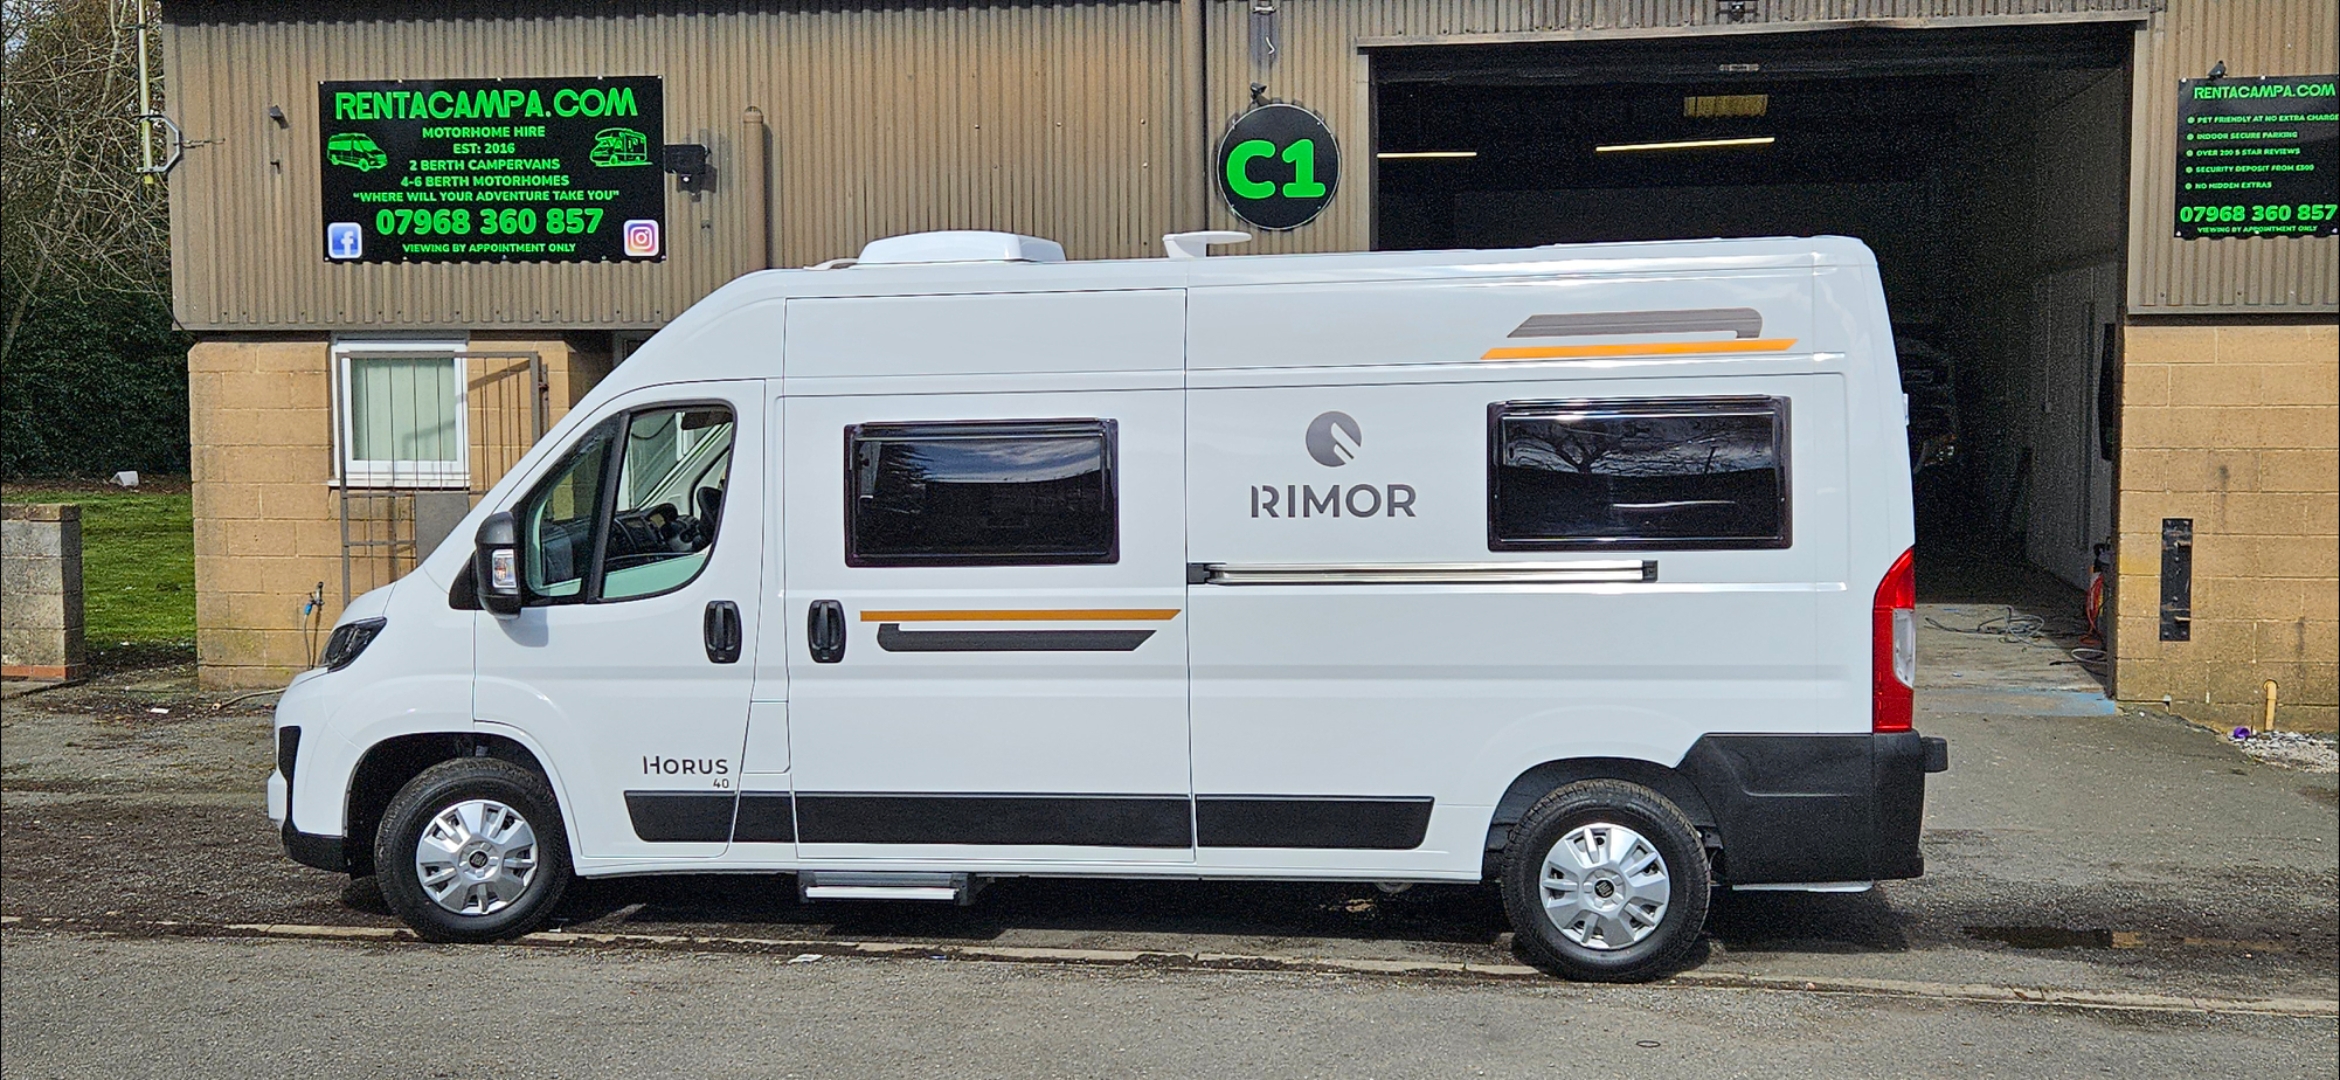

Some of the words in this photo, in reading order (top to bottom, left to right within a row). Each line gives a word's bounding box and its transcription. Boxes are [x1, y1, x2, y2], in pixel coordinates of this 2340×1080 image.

[2194, 83, 2335, 99] RENTACAMPA.COM
[335, 87, 638, 120] RENTACAMPA.COM
[2197, 116, 2212, 124] PET
[2214, 115, 2251, 123] FRIENDLY
[422, 126, 510, 138] MOTORHOME
[514, 126, 545, 137] HIRE
[2262, 131, 2298, 139] PARKING
[453, 142, 481, 154] EST:
[485, 142, 516, 154] 2016
[2264, 147, 2300, 155] REVIEWS
[410, 161, 417, 171] 2
[420, 160, 465, 171] BERTH
[468, 158, 560, 171] CAMPERVANS
[1226, 139, 1326, 199] C1
[400, 176, 423, 187] 4-6
[425, 176, 469, 187] BERTH
[473, 175, 570, 187] MOTORHOMES
[406, 192, 436, 202] WILL
[440, 191, 473, 202] YOUR
[476, 191, 550, 201] ADVENTURE
[552, 191, 584, 201] TAKE
[2180, 205, 2246, 222] 07968
[2252, 205, 2292, 221] 360
[2296, 204, 2338, 221] 857
[376, 208, 471, 235] 07968
[480, 208, 537, 235] 360
[546, 208, 604, 234] 857
[403, 244, 449, 253] VIEWING
[452, 243, 466, 253] BY
[468, 243, 545, 253] APPOINTMENT
[548, 243, 575, 252] ONLY
[1251, 484, 1416, 518] RIMOR
[643, 755, 729, 775] HORUS
[712, 778, 730, 789] 40
